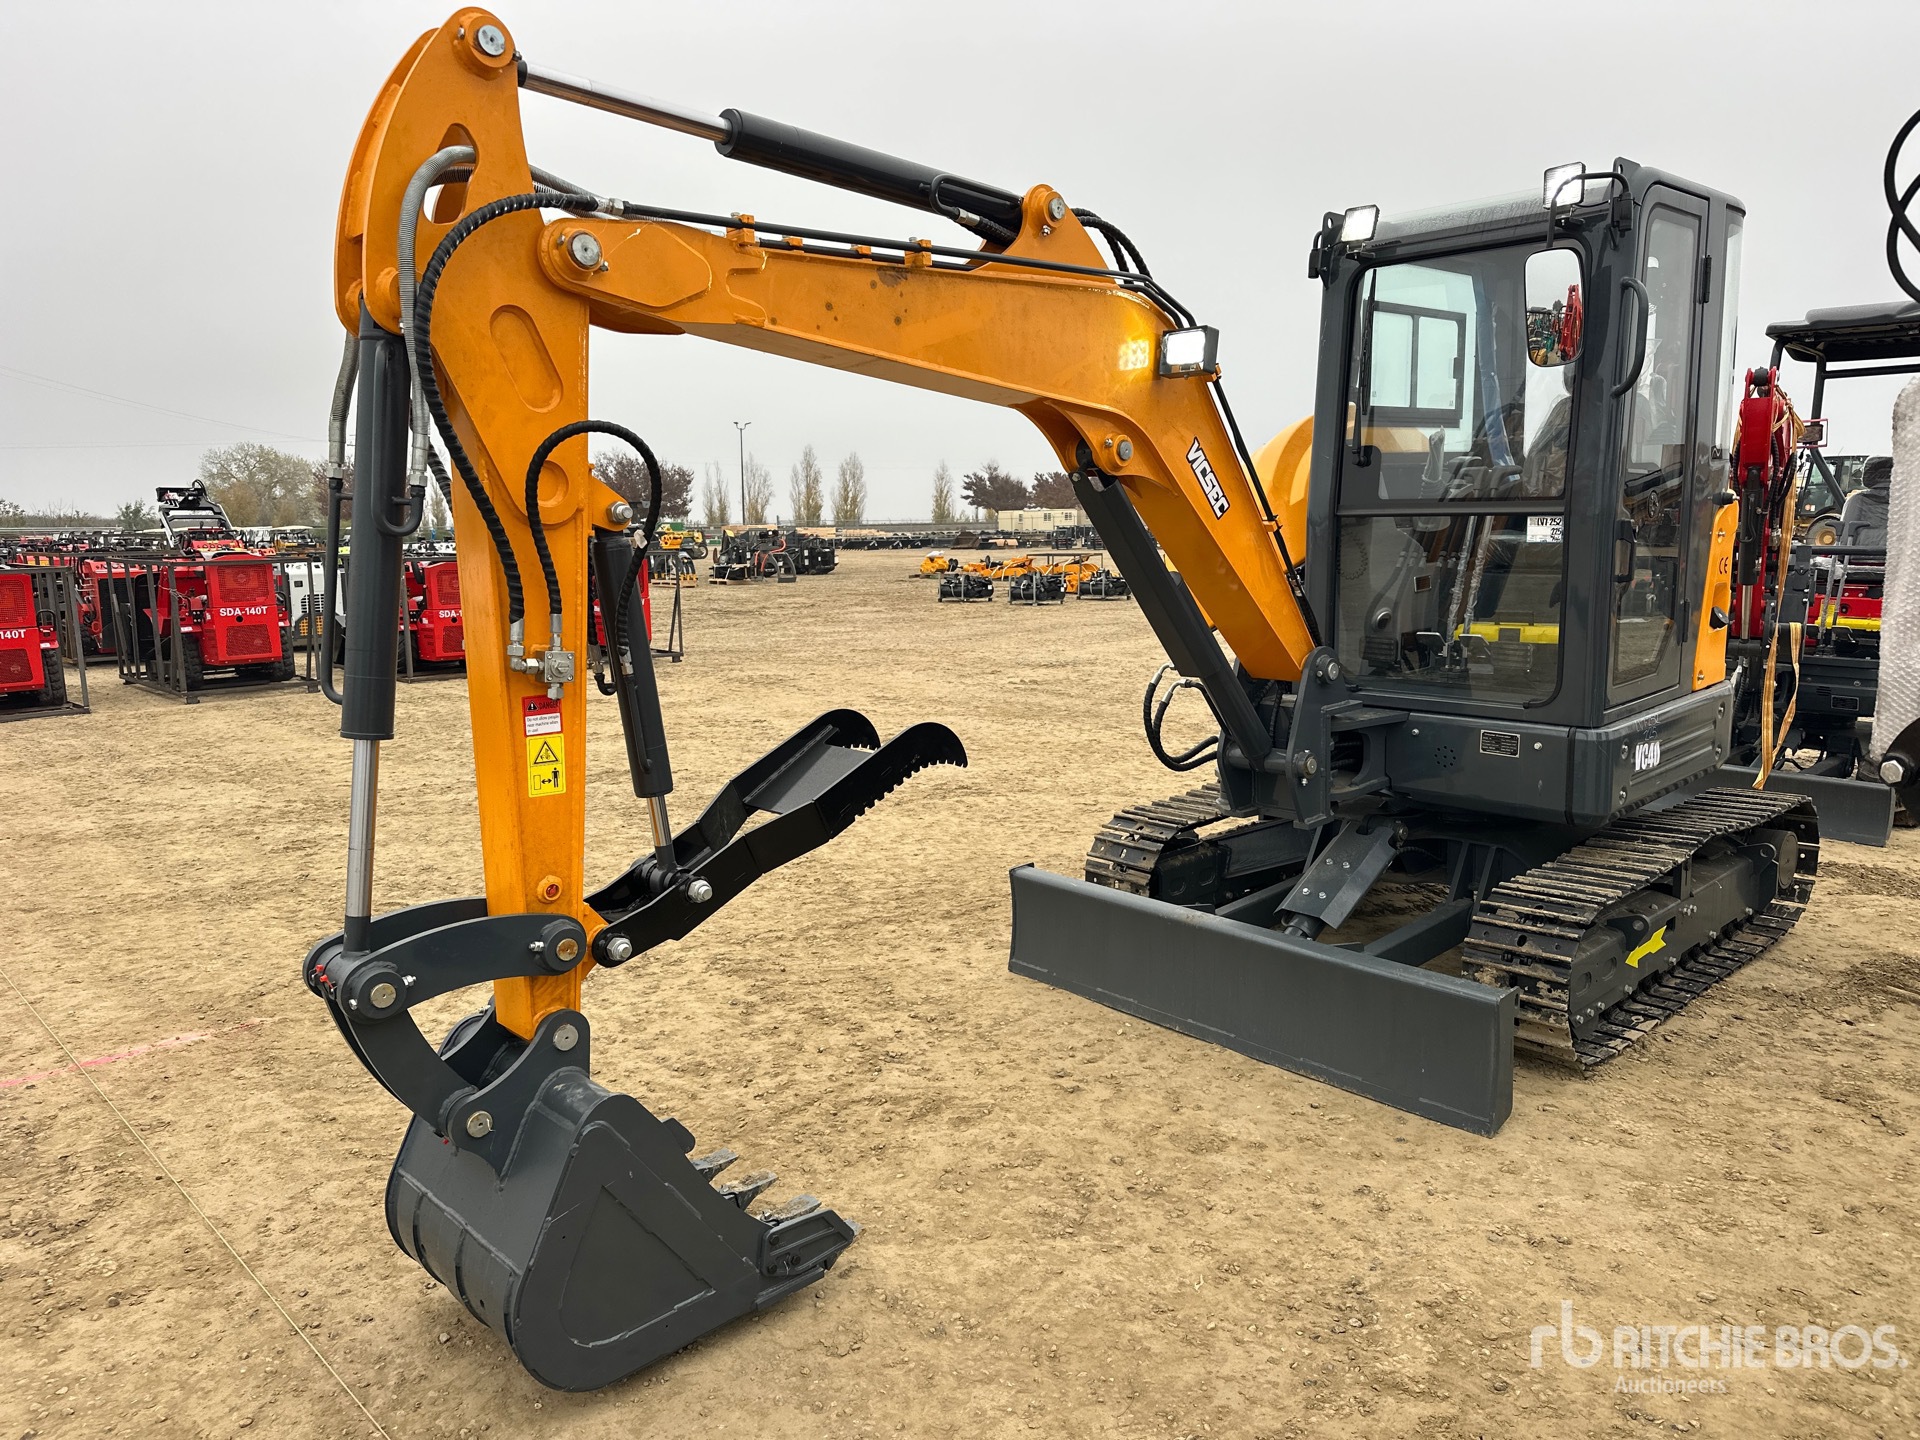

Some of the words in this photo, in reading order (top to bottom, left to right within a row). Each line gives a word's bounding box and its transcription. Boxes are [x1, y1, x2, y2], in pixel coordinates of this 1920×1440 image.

[1186, 436, 1230, 520] VICSEC
[219, 606, 268, 617] SDA-140T
[538, 700, 558, 709] DANGER
[1635, 741, 1660, 771] VC40
